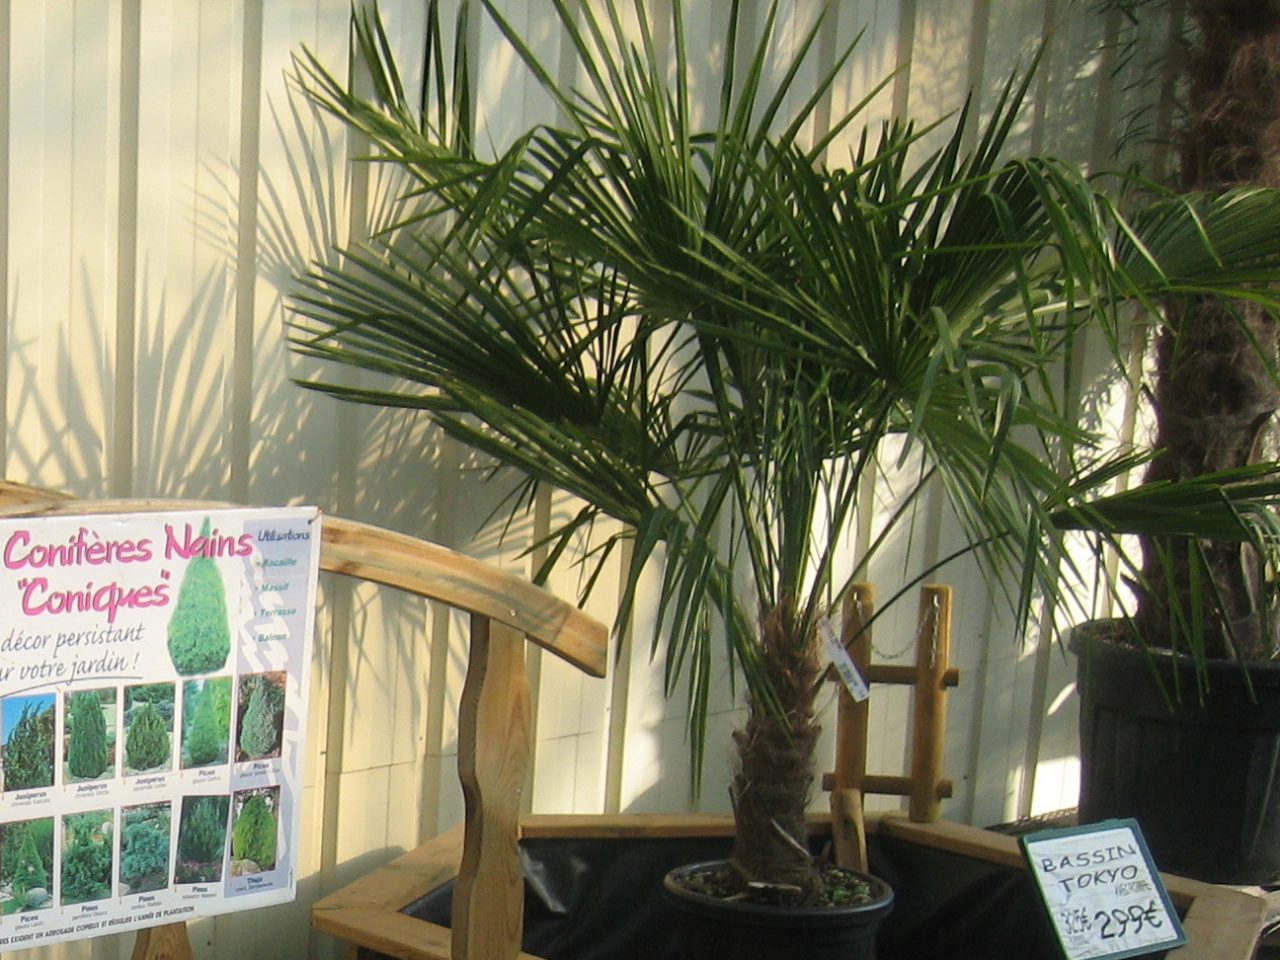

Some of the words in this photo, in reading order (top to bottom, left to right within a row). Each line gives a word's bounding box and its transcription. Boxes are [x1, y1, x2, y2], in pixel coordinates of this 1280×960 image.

[3, 528, 153, 569] Conifères
[164, 523, 254, 560] Nains
[1, 629, 52, 654] décor
[55, 623, 147, 658] persistant
[20, 656, 68, 679] votre
[66, 655, 129, 686] jardin
[1041, 843, 1137, 872] BASSIN
[1059, 865, 1138, 893] TOKYO
[1094, 900, 1162, 939] 299€
